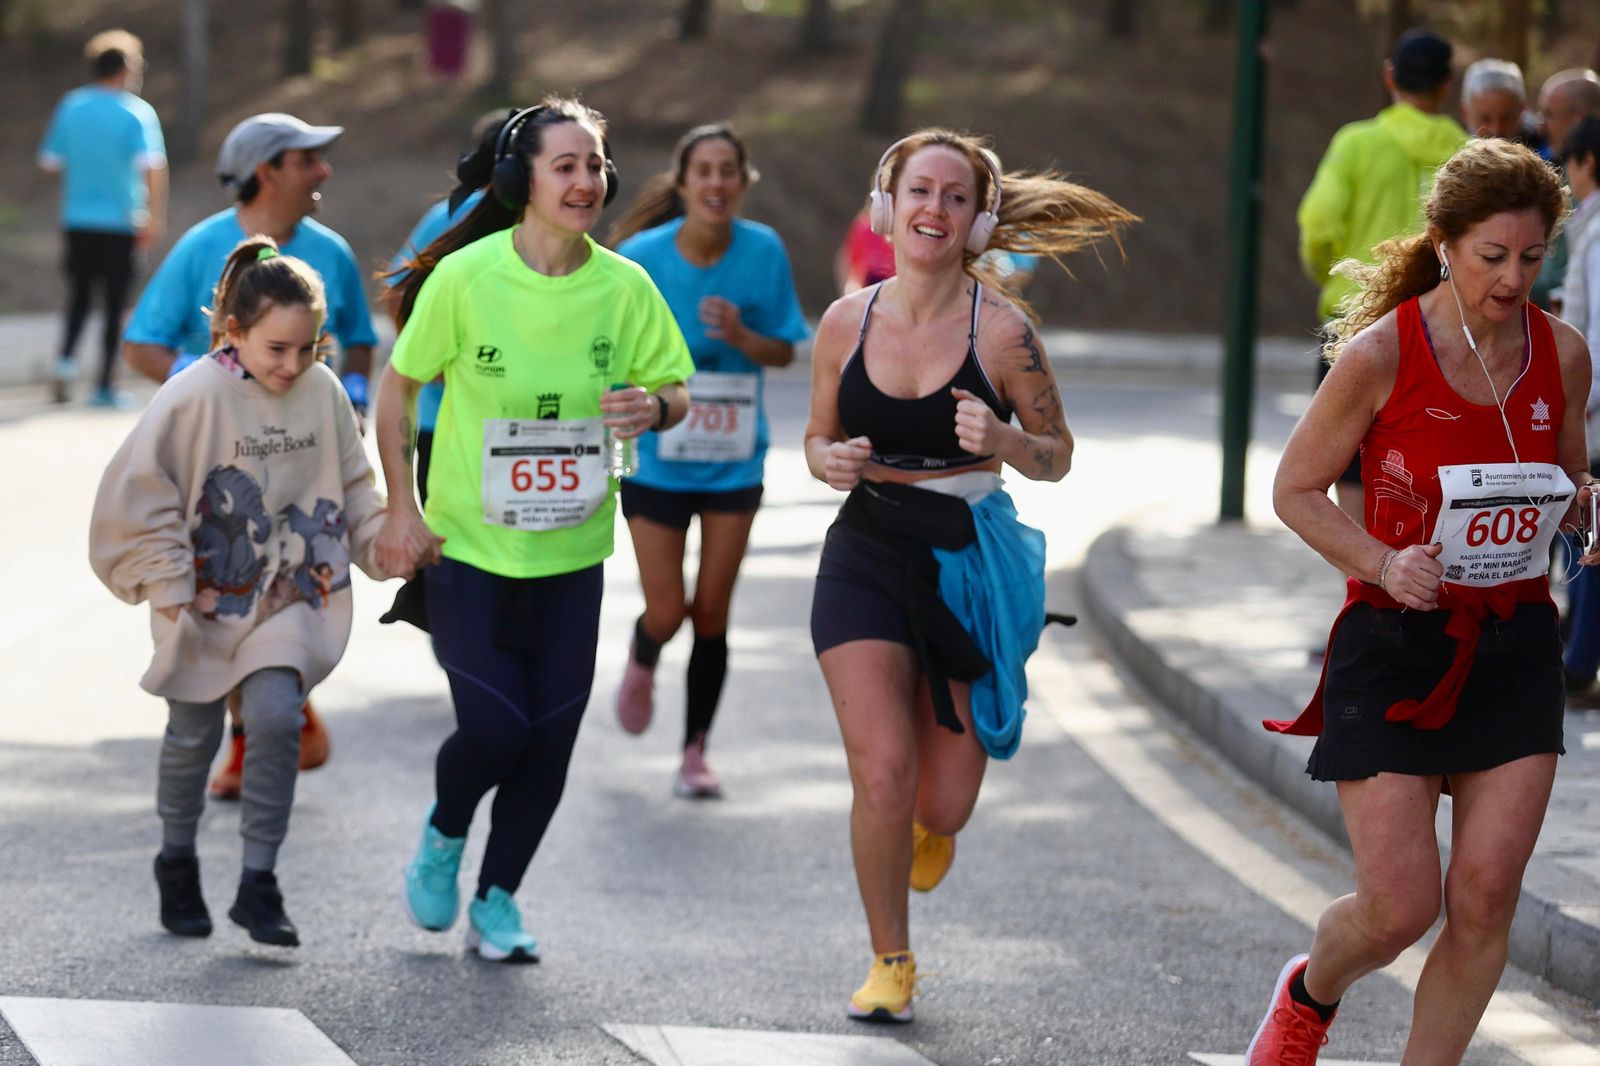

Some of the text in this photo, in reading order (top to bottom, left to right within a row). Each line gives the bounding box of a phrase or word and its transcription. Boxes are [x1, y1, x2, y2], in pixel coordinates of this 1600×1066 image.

[688, 403, 738, 434] 703
[233, 432, 316, 461] Jungle Book
[511, 459, 580, 492] 655
[1485, 473, 1527, 481] Ayuntamieno
[1537, 472, 1553, 481] Málag
[1466, 507, 1541, 547] 608
[1482, 551, 1518, 560] BALLESTEROS
[1468, 571, 1490, 580] PEÑA
[1483, 562, 1500, 570] MINI
